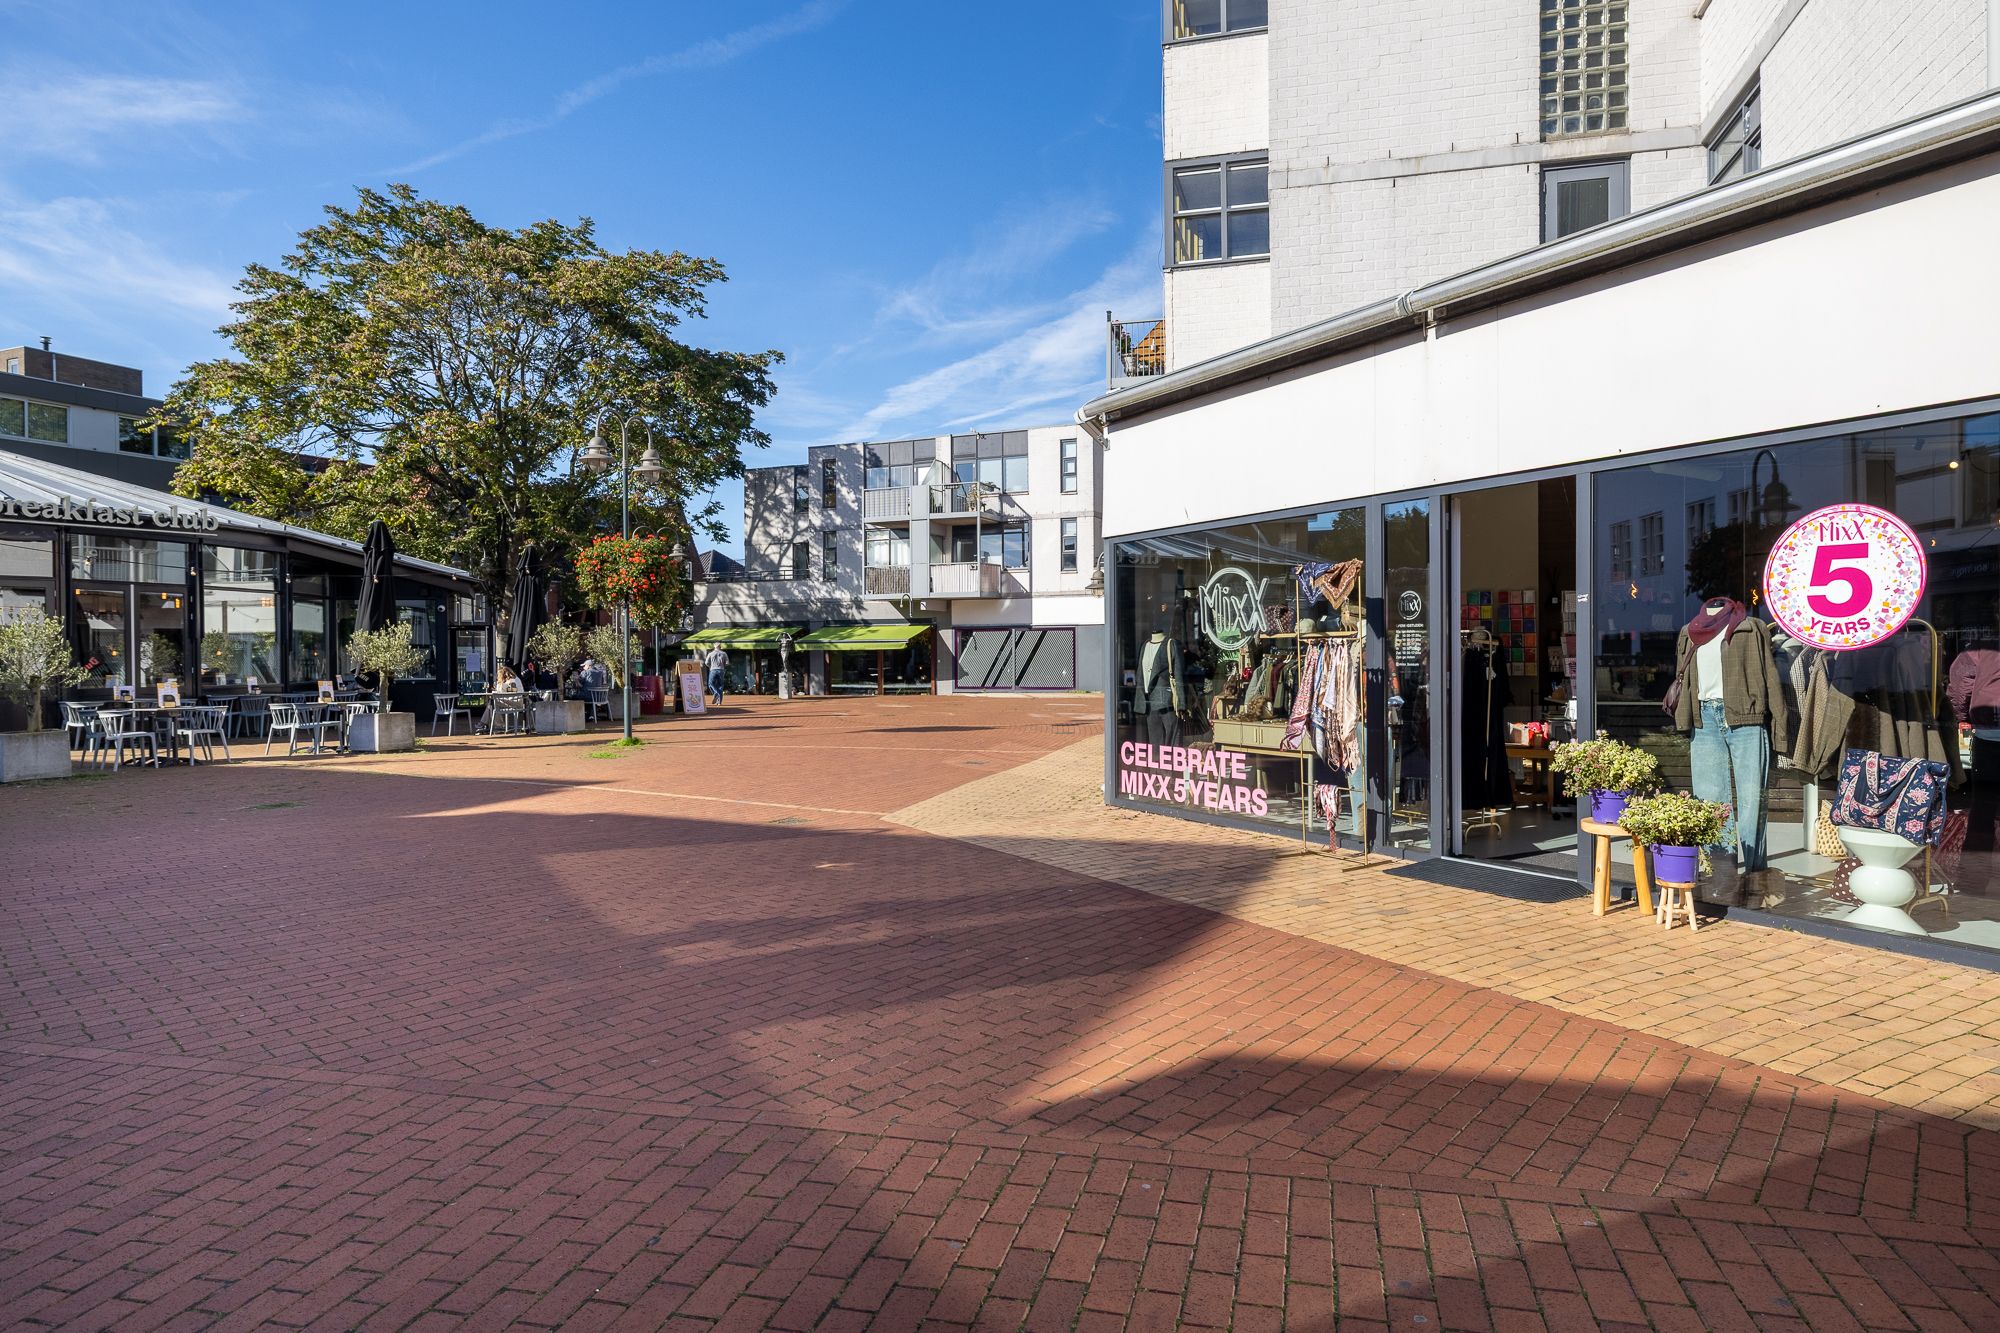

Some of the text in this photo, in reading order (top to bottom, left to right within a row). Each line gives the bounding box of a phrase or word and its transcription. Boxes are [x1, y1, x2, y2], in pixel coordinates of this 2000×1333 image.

[153, 505, 219, 531] club
[1819, 518, 1866, 542] MixX
[1807, 543, 1873, 618] 5
[1199, 577, 1269, 634] MixX
[1809, 616, 1871, 635] YEARS
[1120, 741, 1247, 780] CELEBRATE
[1121, 769, 1268, 817] MIXX 5 YEARS
